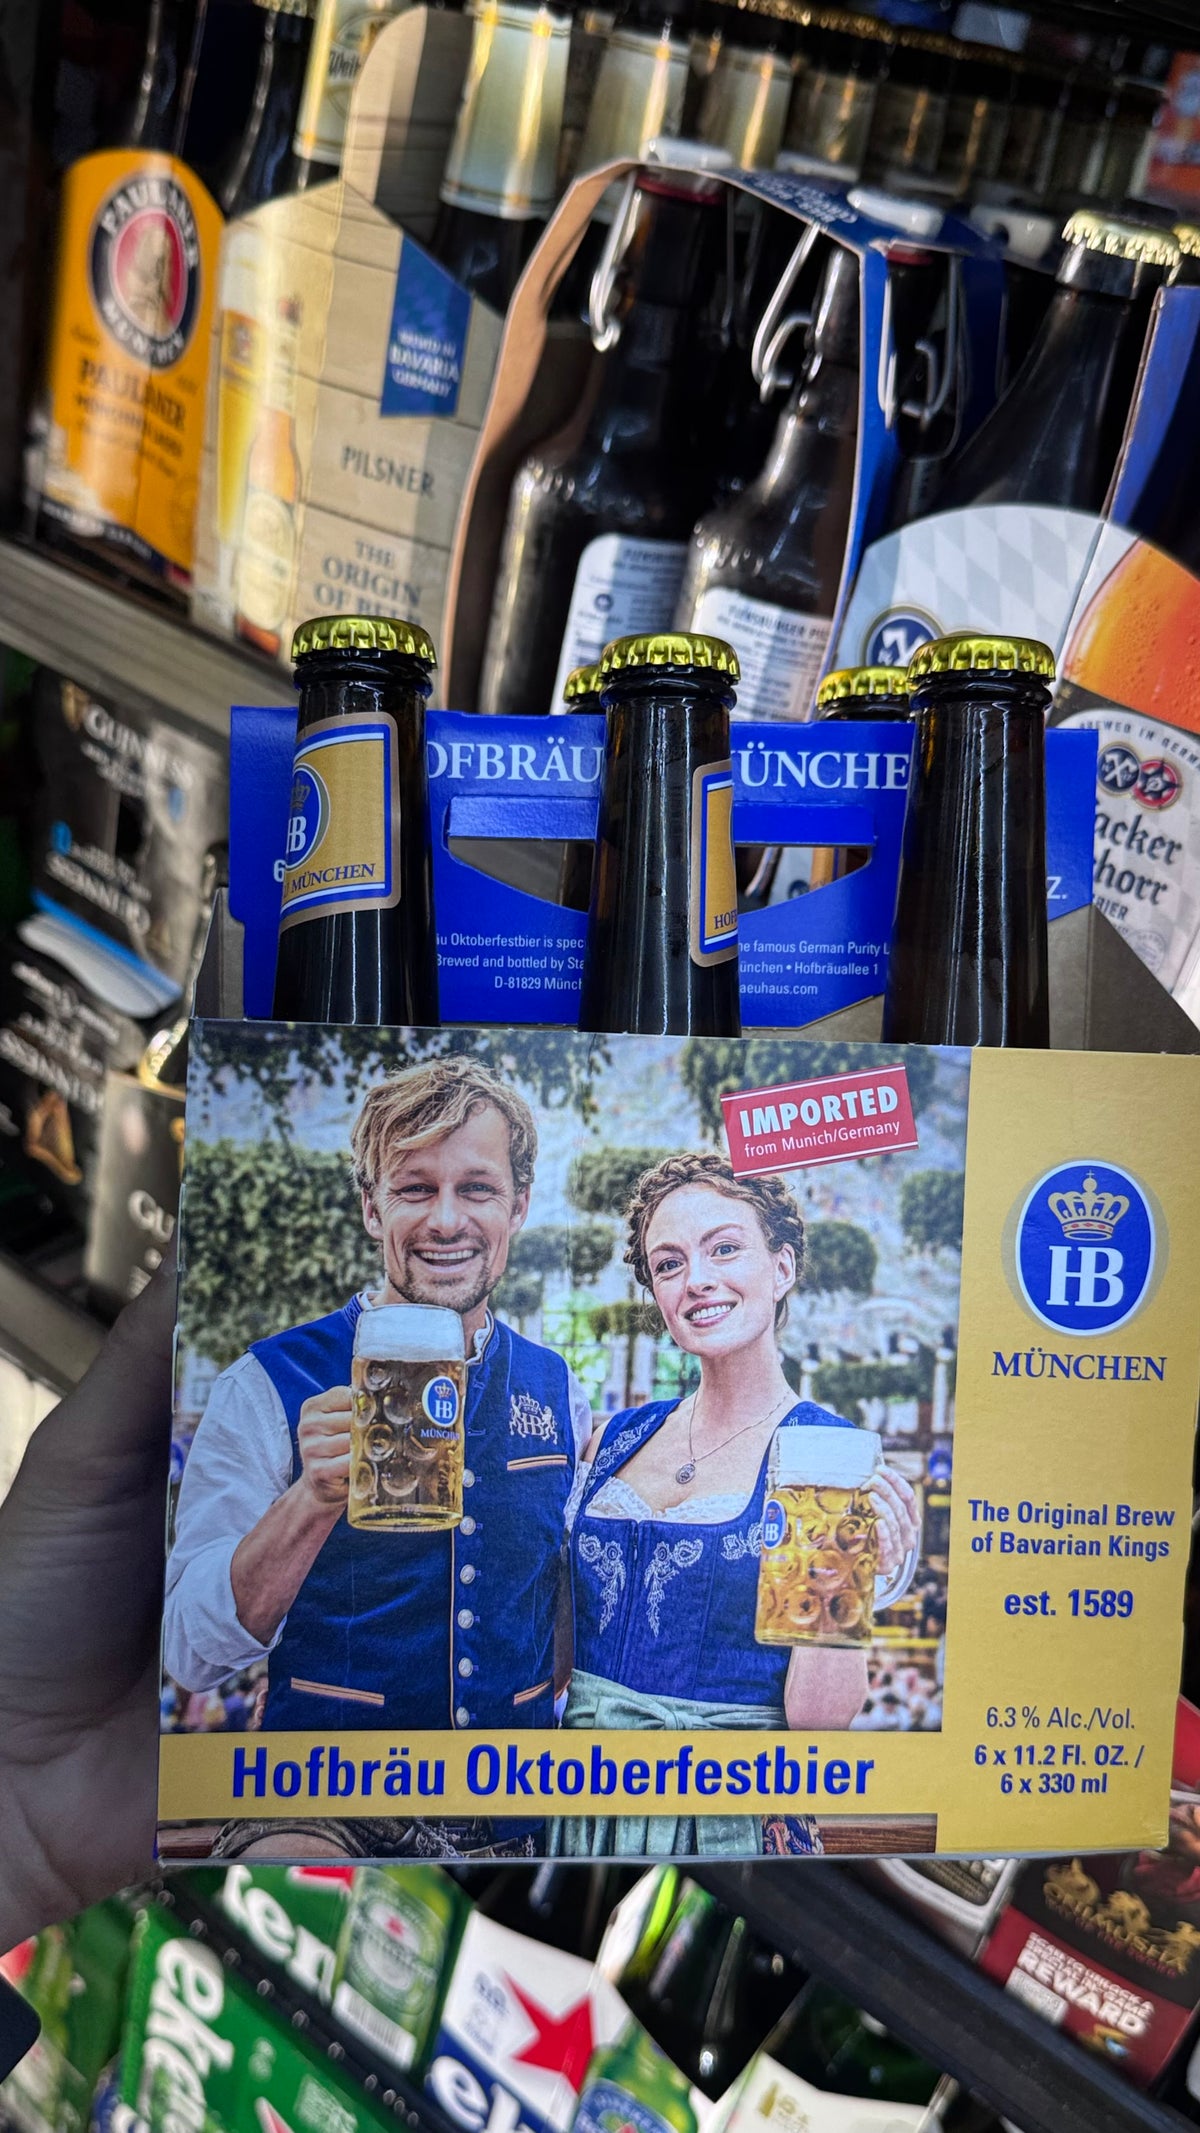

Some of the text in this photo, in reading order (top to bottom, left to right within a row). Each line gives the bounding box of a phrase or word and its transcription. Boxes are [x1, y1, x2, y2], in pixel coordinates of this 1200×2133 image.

[389, 345, 459, 383] BAVARIA
[392, 369, 451, 397] GERMANY
[340, 446, 435, 498] PILSNER
[355, 539, 394, 567] THE
[322, 554, 422, 607] ORIGIN
[314, 582, 347, 611] OF
[1139, 727, 1155, 740] IN
[427, 736, 604, 783] OFBRÄU
[731, 741, 910, 790] ÜNCHE
[1095, 813, 1182, 866] acker
[291, 863, 376, 894] MÜNCHEN
[1047, 876, 1067, 900] Z.
[1094, 848, 1168, 905] horr
[714, 909, 737, 929] HOF
[451, 933, 541, 947] Oktoberfestbier
[543, 936, 553, 948] is
[556, 938, 585, 950] spec
[753, 940, 796, 953] famous
[799, 940, 844, 954] German
[847, 941, 880, 957] Purity
[883, 942, 890, 955] L
[482, 955, 504, 967] and
[507, 956, 547, 969] bottled
[550, 957, 564, 971] by
[567, 957, 584, 969] Sta
[739, 961, 878, 975] ünchen Hofbräuallee 1
[495, 976, 582, 990] D-81829 Münch
[739, 982, 818, 995] aeuhaus.com
[739, 1085, 899, 1138] IMPORTED
[744, 1121, 900, 1158] from Munich/Germany
[1046, 1245, 1124, 1308] HB
[991, 1346, 1168, 1382] MÜNCHEN
[434, 1400, 453, 1419] HB
[968, 1499, 1175, 1530] The Original Brew
[765, 1523, 779, 1541] HB
[971, 1531, 1170, 1562] of Bavarian Kings
[1004, 1588, 1134, 1617] est. 1589
[986, 1706, 1135, 1731] 6.3 % Alc./Vol.
[974, 1744, 987, 1765] 6
[993, 1750, 1007, 1765] x
[1014, 1744, 1055, 1766] 11.2
[1062, 1744, 1086, 1766] Fl.
[1094, 1745, 1129, 1766] OZ.
[232, 1743, 875, 1798] Hofbräu Oktoberfestbier
[1000, 1772, 1107, 1794] 6 x 330 ml
[1017, 1951, 1148, 2037] REWARD
